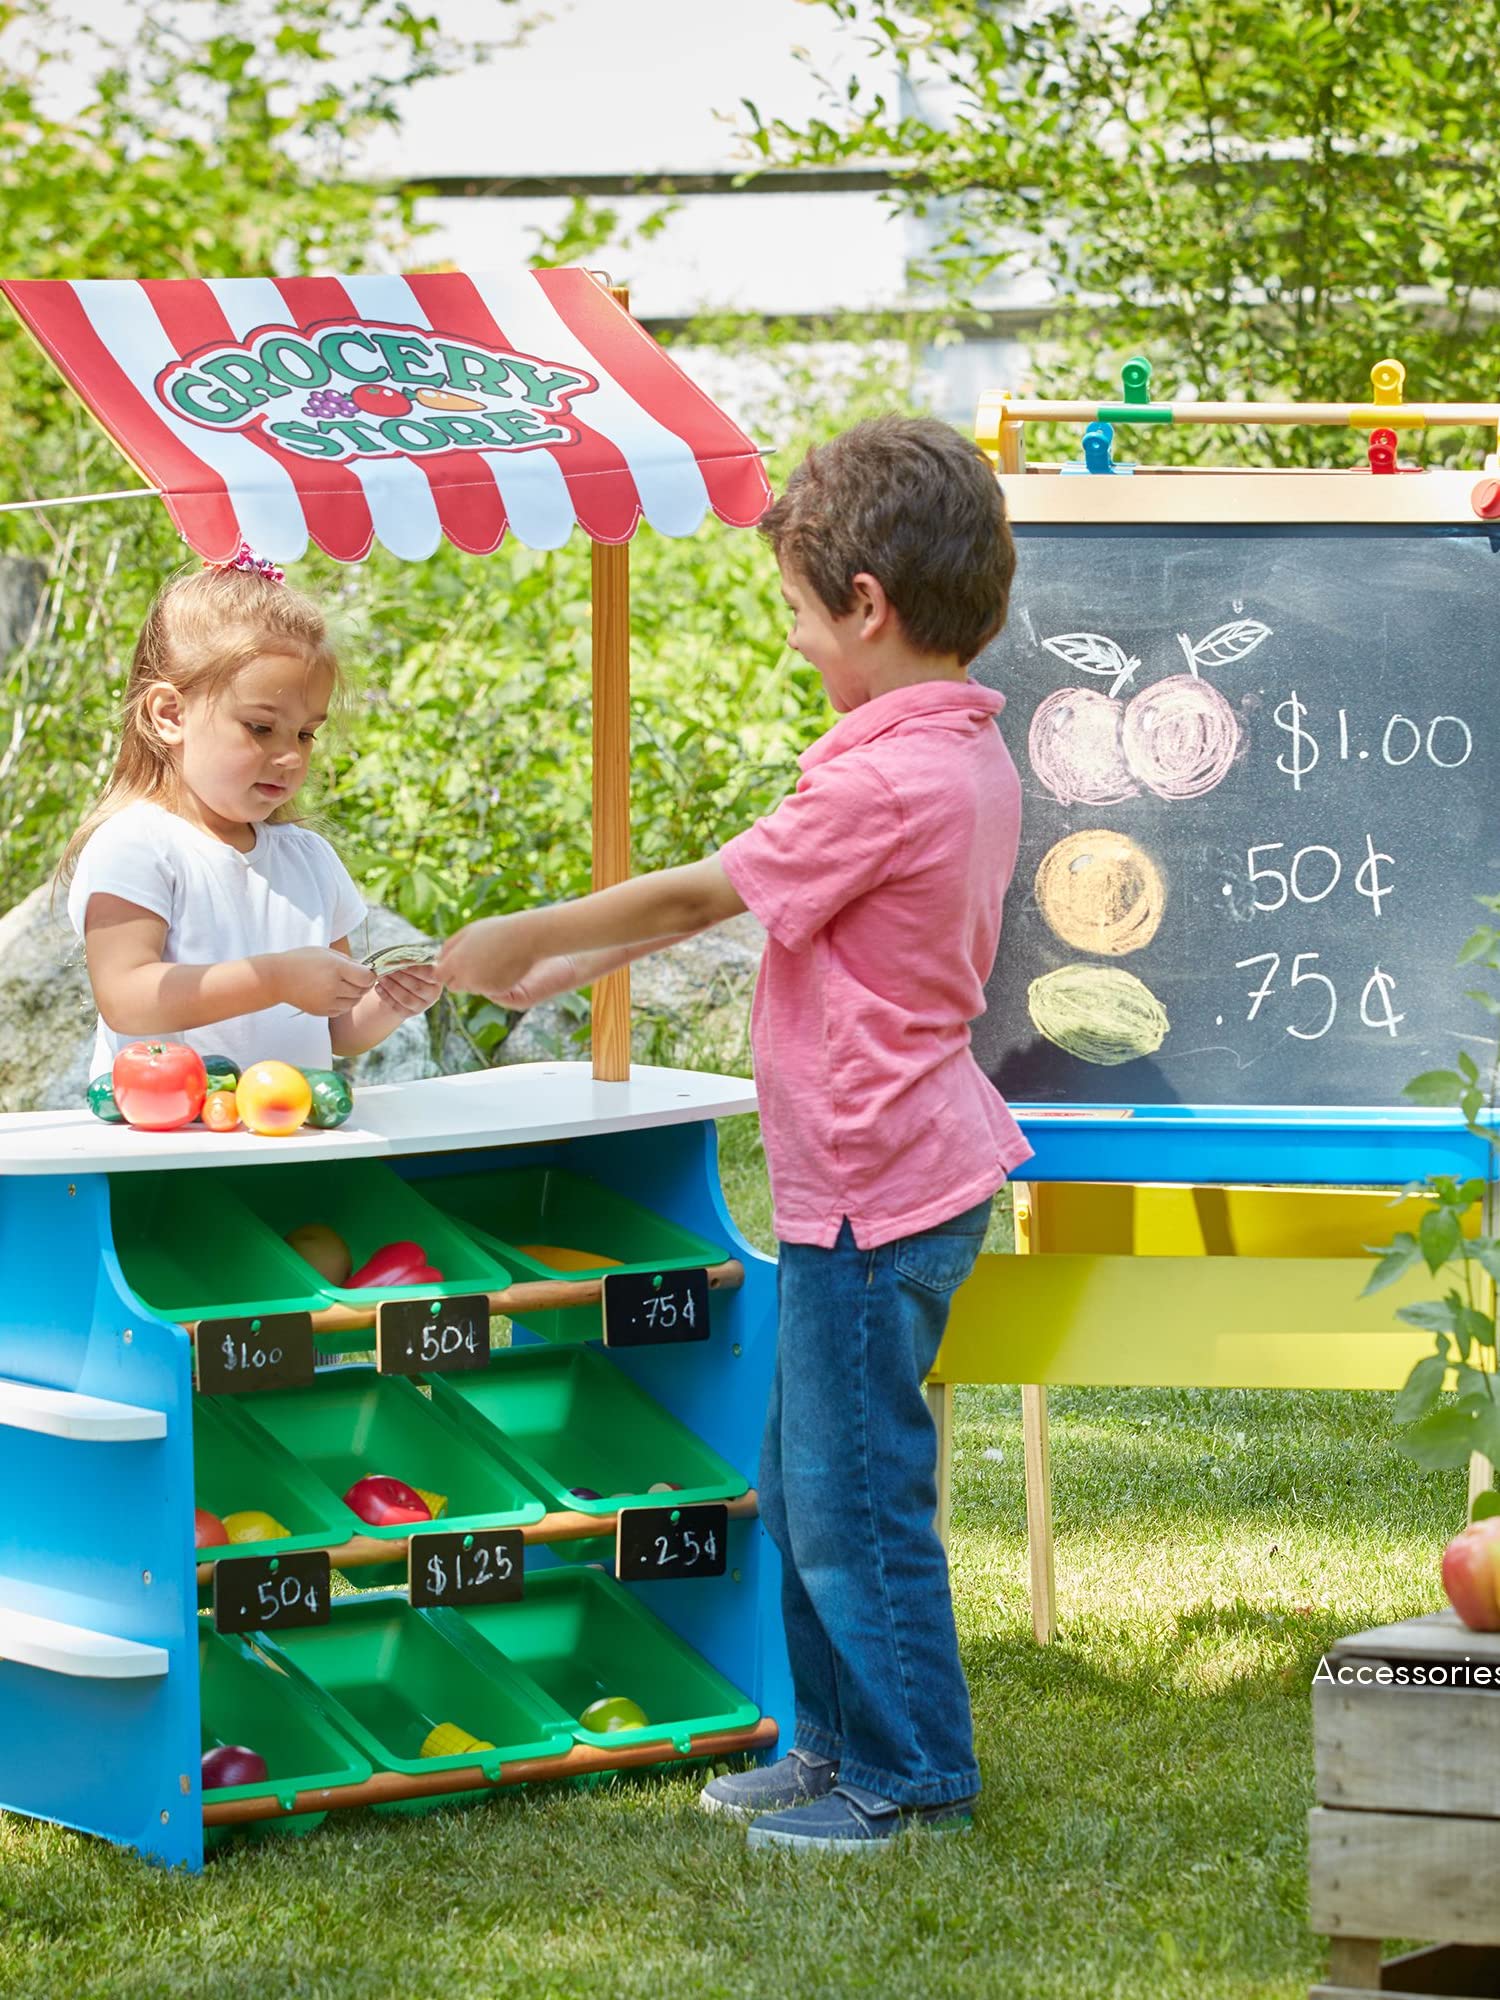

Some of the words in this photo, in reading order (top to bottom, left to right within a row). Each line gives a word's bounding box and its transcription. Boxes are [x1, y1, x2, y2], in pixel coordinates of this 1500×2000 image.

[172, 331, 581, 422] GROCERY
[270, 410, 563, 457] STORE
[1273, 690, 1473, 790] $1.00
[1222, 834, 1396, 917] .50¢
[1215, 952, 1405, 1040] .75¢
[631, 1288, 696, 1328] .75¢
[221, 1333, 283, 1371] $1.00
[405, 1319, 480, 1362] .50¢
[426, 1546, 514, 1596] $1.25
[640, 1529, 717, 1566] .25¢
[239, 1575, 318, 1620] .50¢
